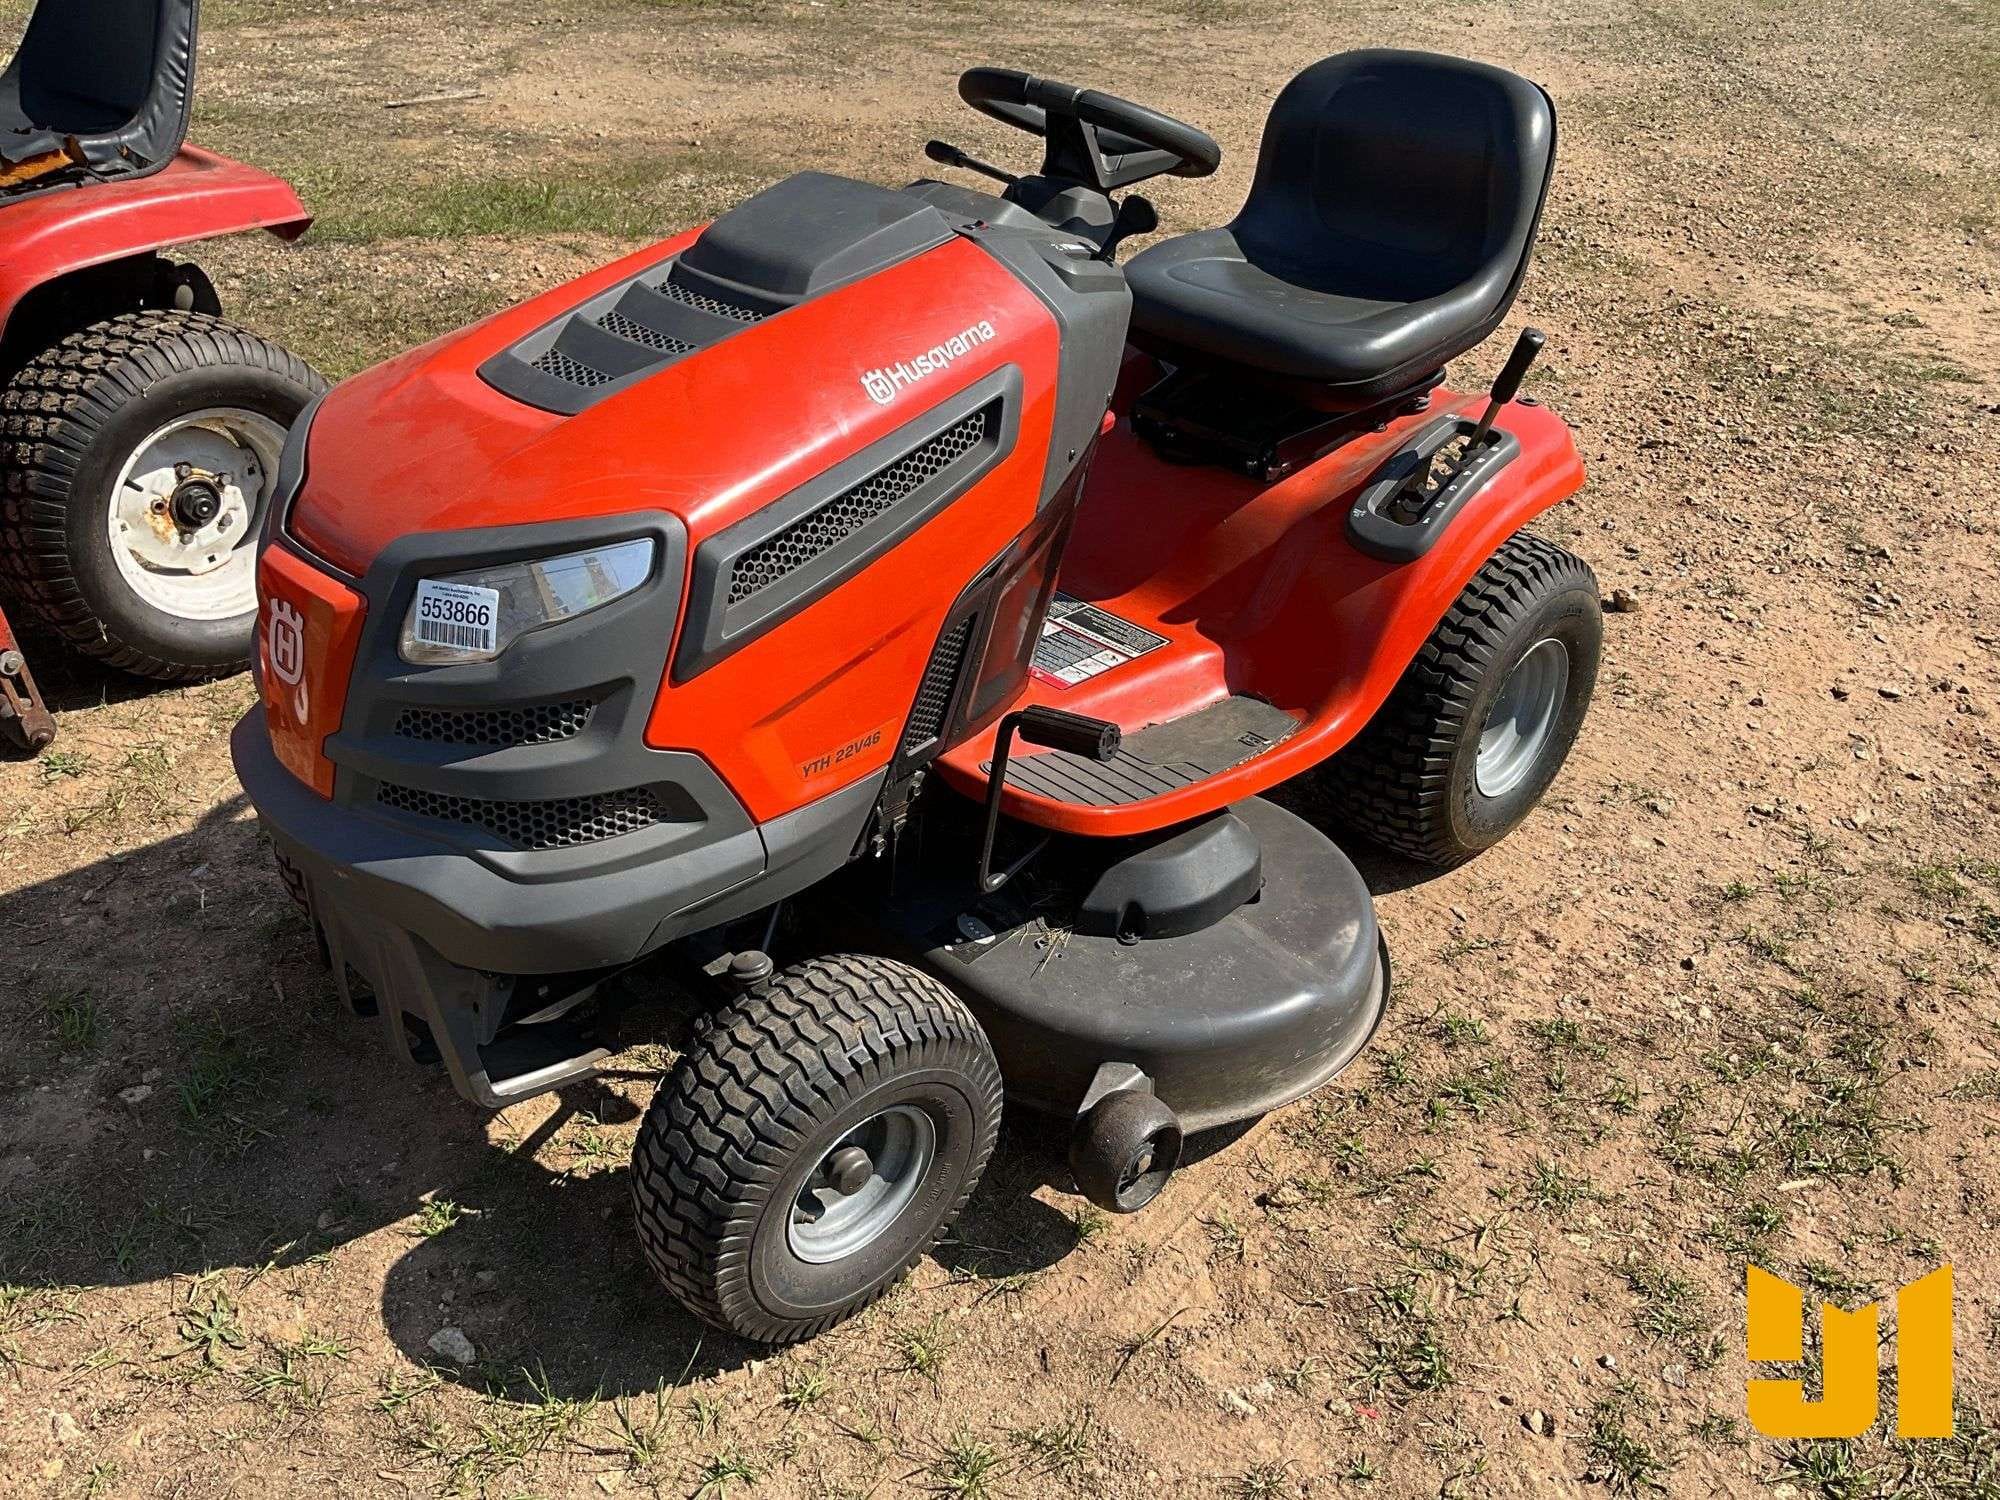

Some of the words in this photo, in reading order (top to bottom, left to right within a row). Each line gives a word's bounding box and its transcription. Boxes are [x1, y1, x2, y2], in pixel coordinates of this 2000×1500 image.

[884, 320, 996, 390] Husqvarna
[421, 596, 490, 626] 553866
[802, 755, 831, 778] YTH
[835, 731, 881, 763] 22V46
